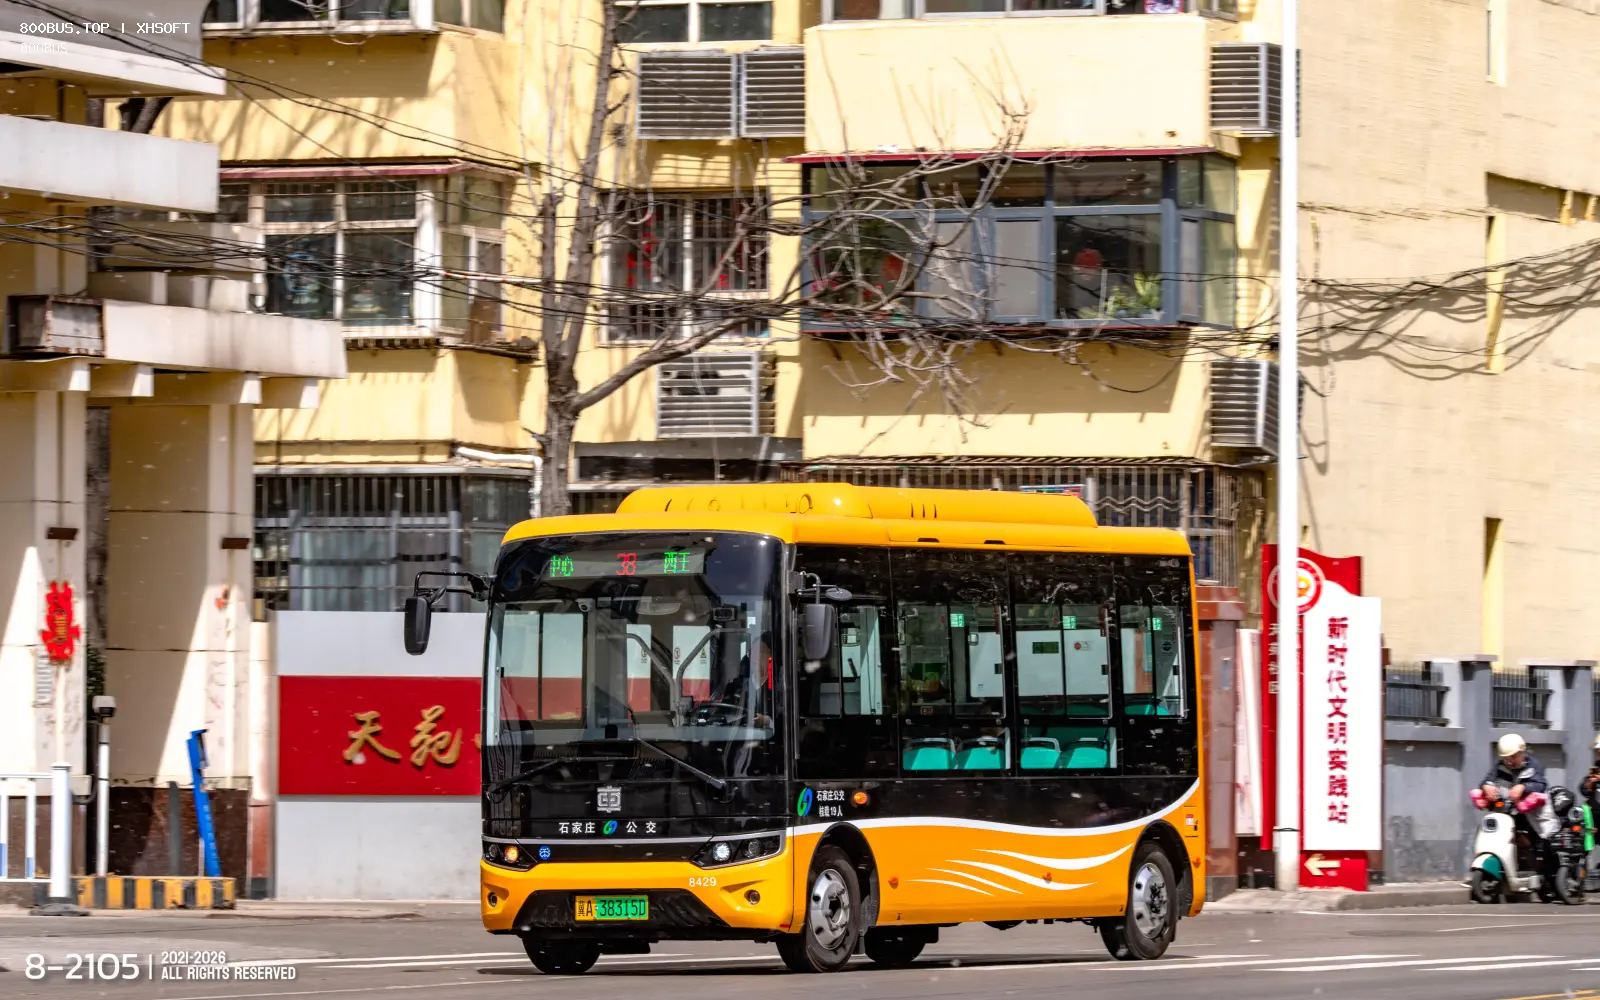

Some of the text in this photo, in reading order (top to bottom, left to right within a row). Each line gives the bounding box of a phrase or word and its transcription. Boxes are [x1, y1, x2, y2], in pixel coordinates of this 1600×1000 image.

[616, 552, 637, 576] 38
[1326, 616, 1349, 824] 新时代文明实践站
[343, 705, 481, 767] 天苑
[816, 789, 845, 802] 石家庄公交
[558, 821, 596, 834] 石家庄
[688, 876, 717, 888] 8429
